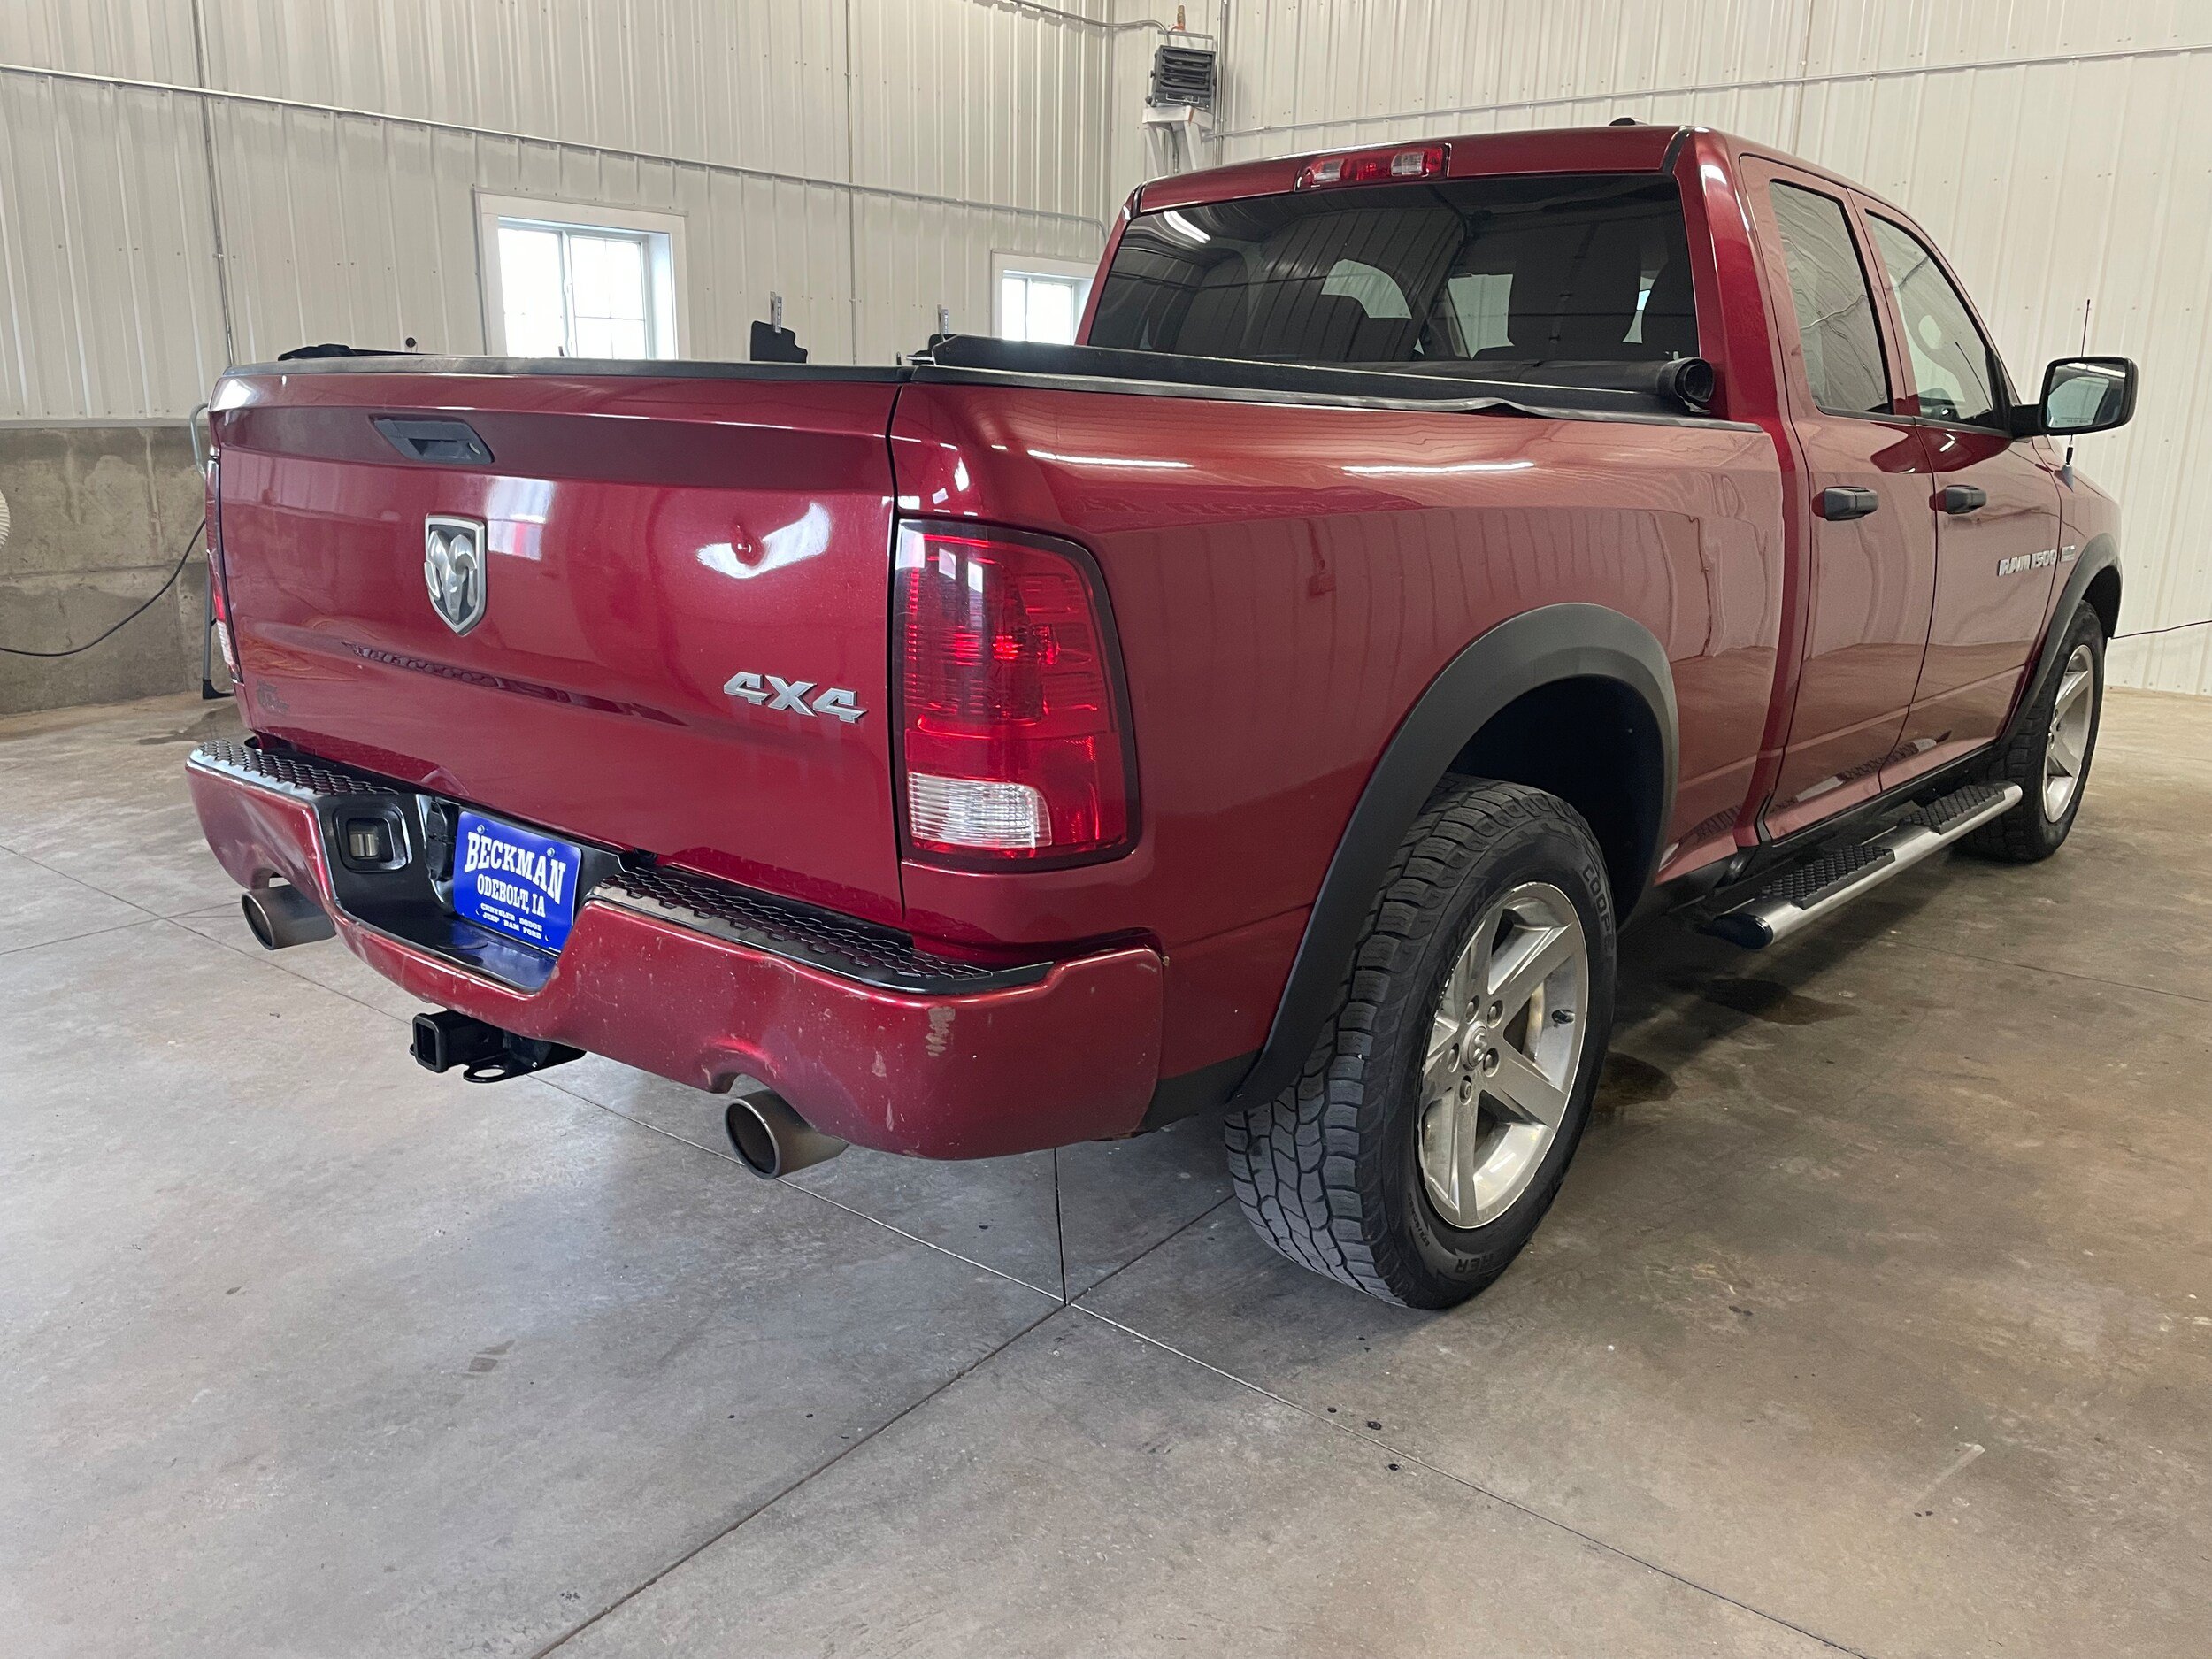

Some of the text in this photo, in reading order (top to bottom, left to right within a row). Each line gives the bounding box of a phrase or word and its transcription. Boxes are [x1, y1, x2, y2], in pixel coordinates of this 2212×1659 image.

[1997, 554, 2031, 576] RAM
[2031, 549, 2057, 569] 1500
[465, 832, 565, 903] BECKMAN
[477, 873, 546, 918] ODEBOLT, IA
[480, 903, 542, 932] CHRYSLER DODGE
[483, 912, 541, 940] JEEP RAM FORD
